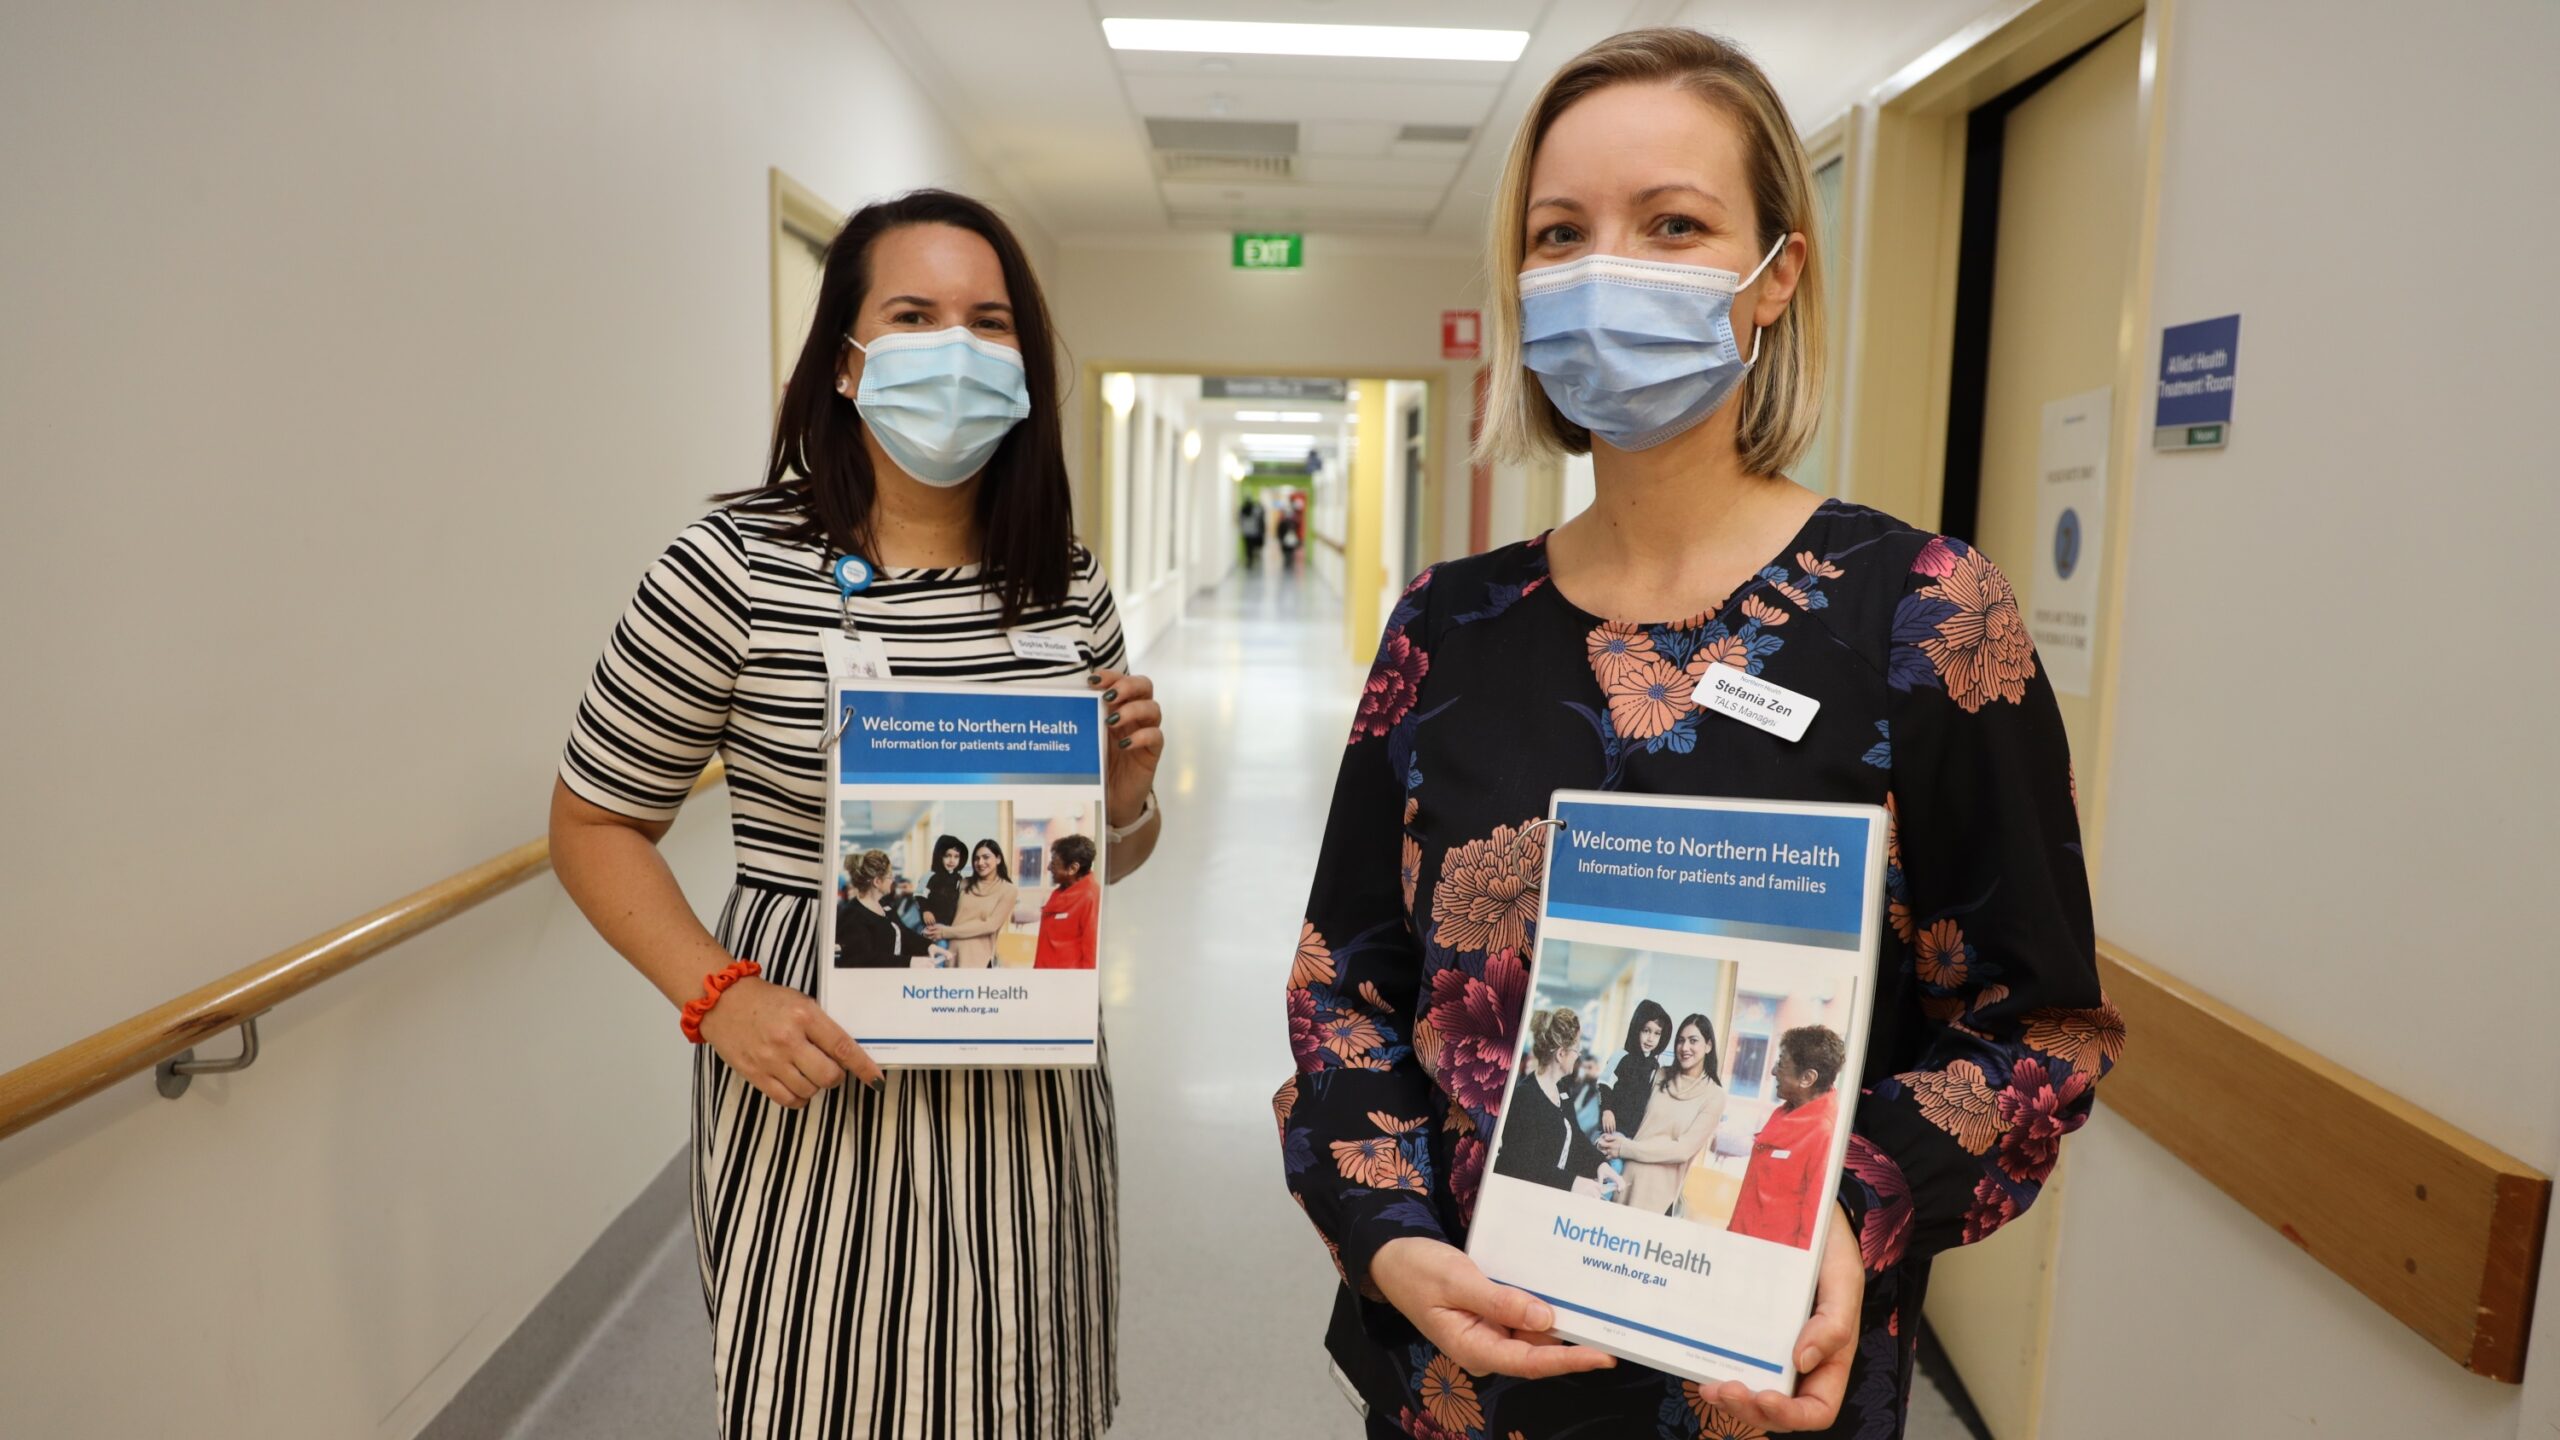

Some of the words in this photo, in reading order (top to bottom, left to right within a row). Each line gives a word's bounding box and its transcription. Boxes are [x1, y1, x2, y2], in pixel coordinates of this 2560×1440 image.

[1243, 239, 1290, 266] EXIT
[2166, 354, 2196, 374] Allied
[2197, 348, 2228, 369] Health
[2158, 378, 2204, 398] Treatment
[2205, 373, 2235, 393] Room
[1714, 696, 1738, 711] TALS
[1739, 705, 1777, 727] Manager
[1715, 679, 1765, 706] Stefania
[1766, 699, 1793, 717] Zen
[861, 716, 935, 732] Welcome
[939, 718, 954, 732] to
[957, 718, 1026, 734] Northern
[1029, 719, 1078, 735] Health
[871, 737, 939, 750] Information
[941, 739, 957, 750] for
[959, 740, 1004, 752] patients
[1007, 740, 1026, 751] and
[1028, 740, 1070, 752] families
[1572, 830, 1652, 853] Welcome
[1656, 837, 1675, 855] to
[1679, 837, 1767, 862] Northern
[1771, 843, 1840, 868] Health
[1578, 859, 1653, 879] Information
[1656, 864, 1677, 880] for
[1679, 868, 1736, 887] patients
[1739, 874, 1765, 889] and
[1768, 876, 1826, 894] families
[903, 985, 975, 999] Northern
[977, 985, 1028, 1000] Health
[931, 1004, 999, 1015] www.nh.org.au
[1553, 1215, 1641, 1257] Northern
[1643, 1239, 1712, 1276] Health
[1582, 1255, 1668, 1287] www.nh.org.au
